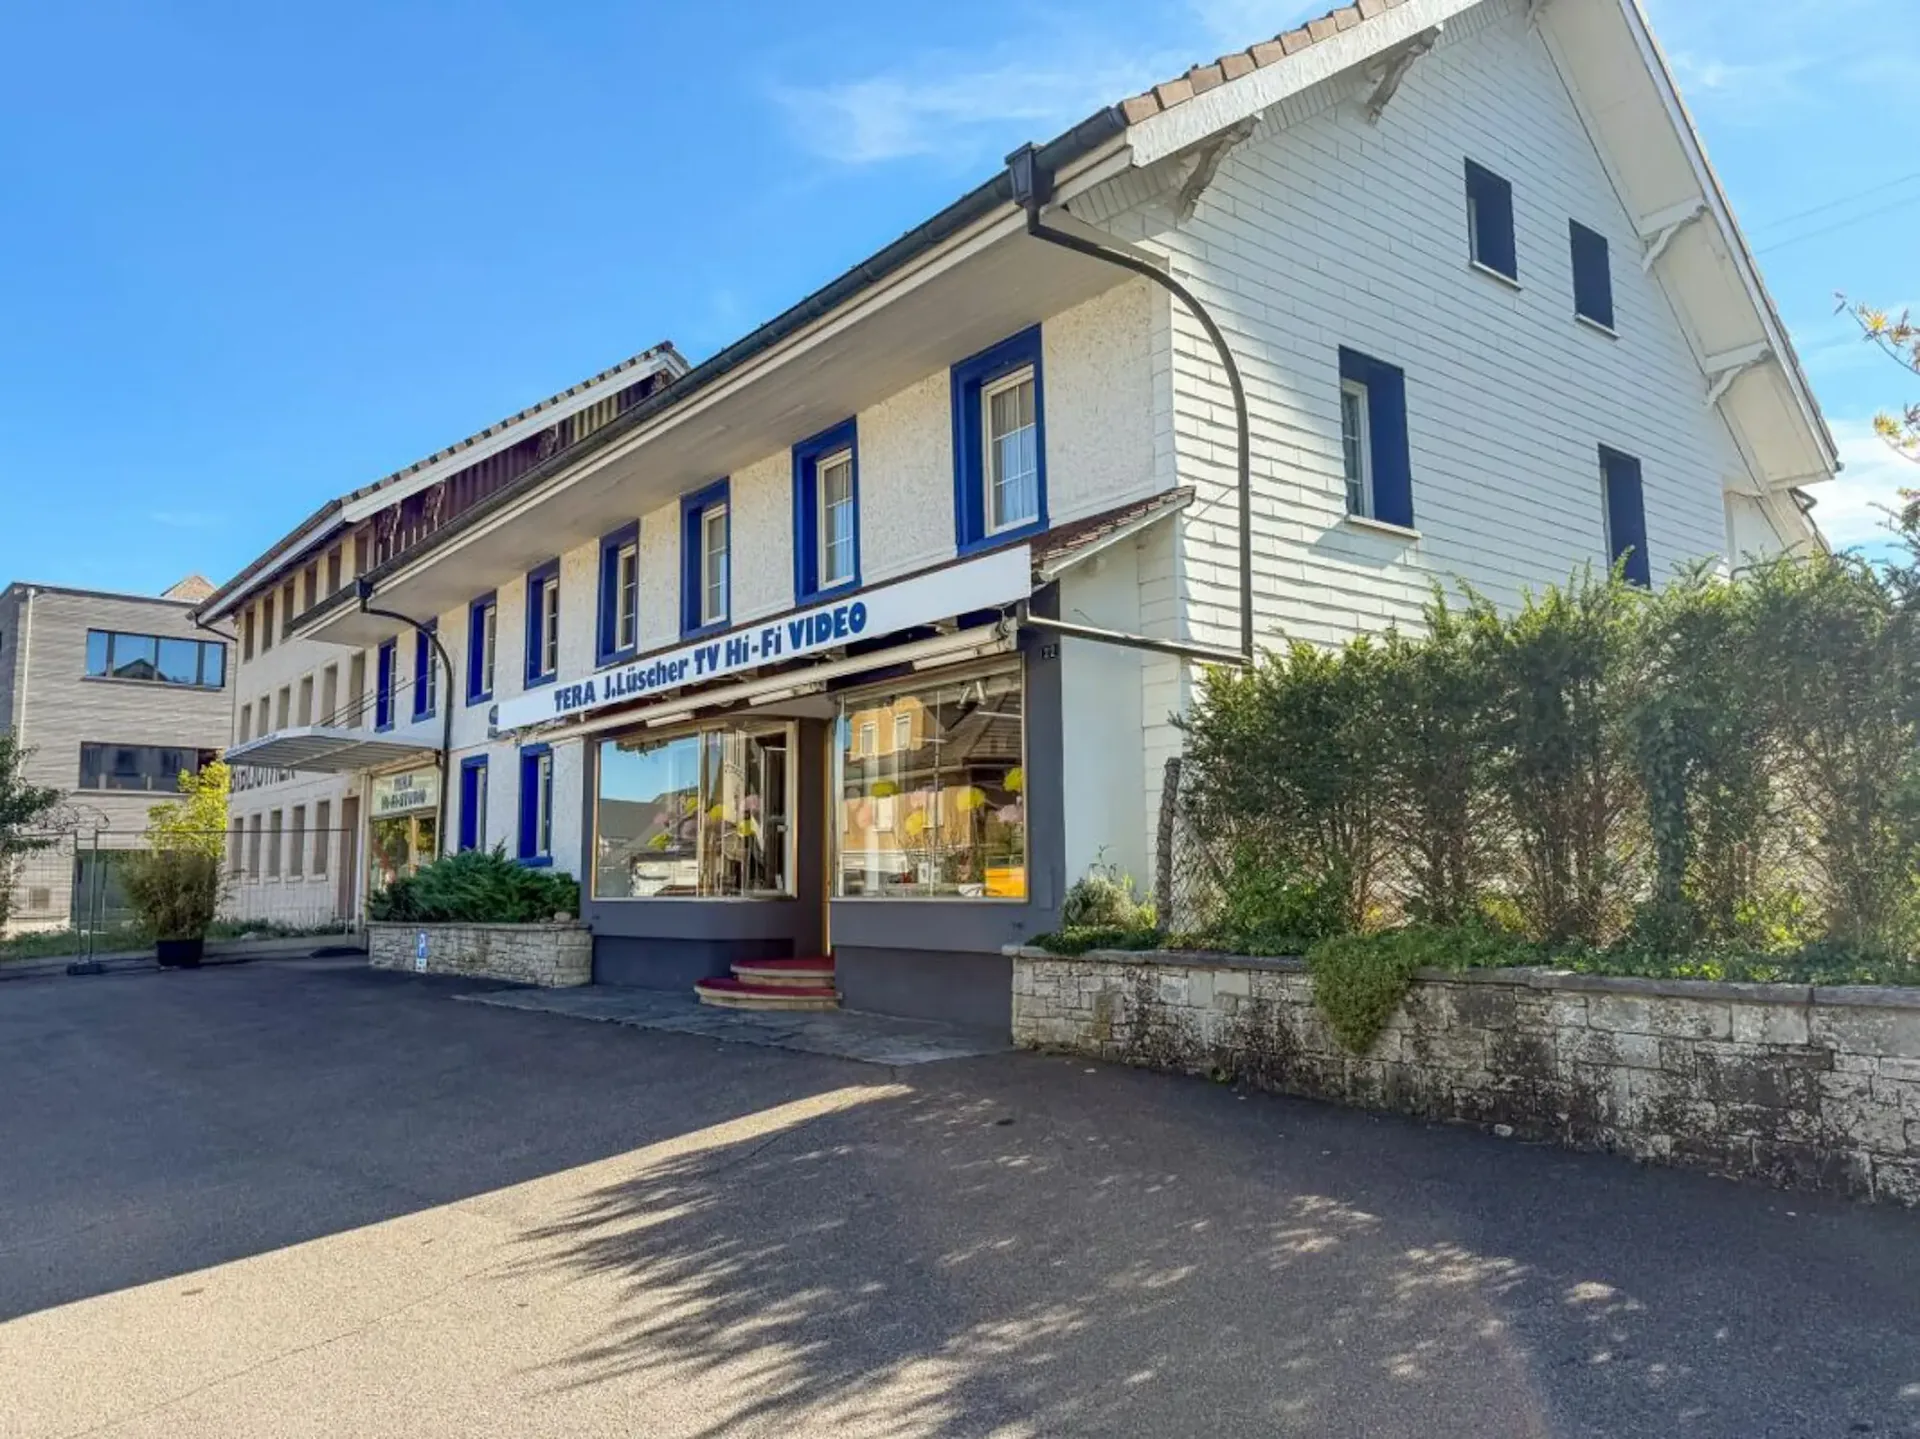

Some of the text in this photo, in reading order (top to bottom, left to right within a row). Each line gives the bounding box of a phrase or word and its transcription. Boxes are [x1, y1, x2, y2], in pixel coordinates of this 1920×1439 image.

[554, 602, 867, 712] TERA J.Lüscher TV Hi-Fi VIDEO
